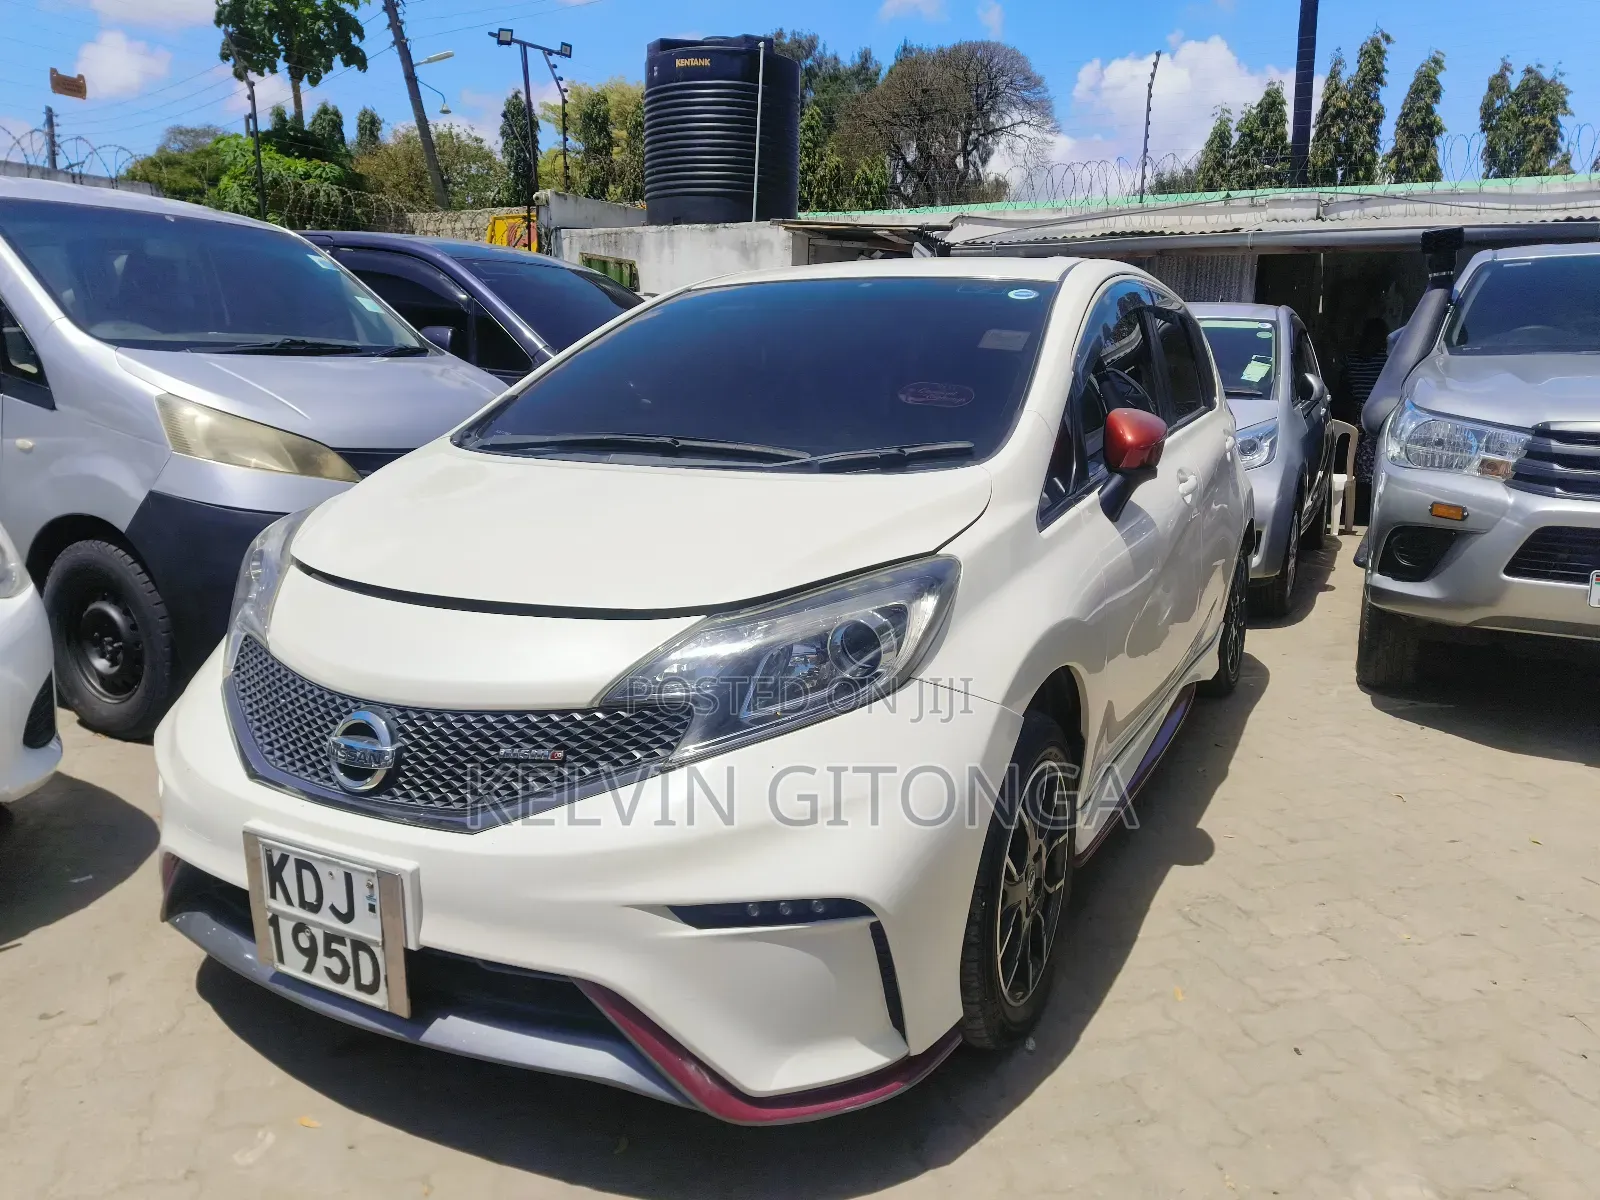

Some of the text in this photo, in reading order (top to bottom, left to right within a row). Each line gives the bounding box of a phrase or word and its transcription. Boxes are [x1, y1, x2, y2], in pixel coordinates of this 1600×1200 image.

[675, 58, 711, 67] KENTANK
[330, 742, 383, 764] NISSAN
[265, 849, 355, 925] KDJ
[268, 912, 381, 996] 195D
